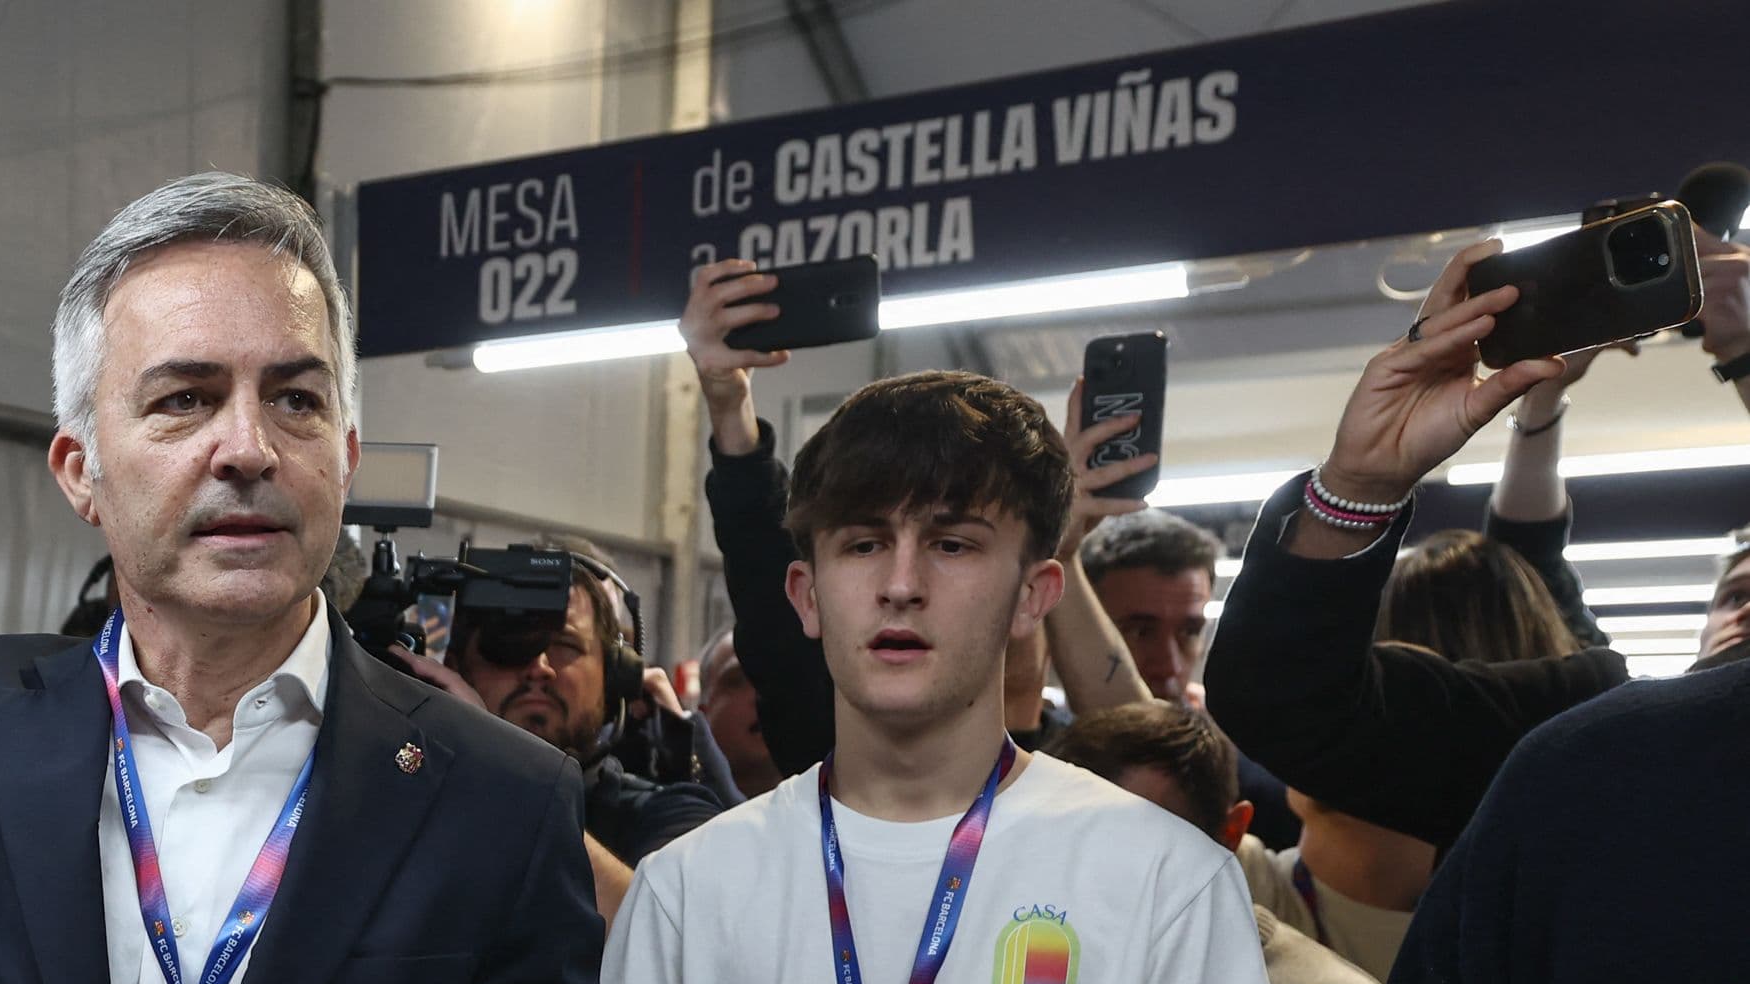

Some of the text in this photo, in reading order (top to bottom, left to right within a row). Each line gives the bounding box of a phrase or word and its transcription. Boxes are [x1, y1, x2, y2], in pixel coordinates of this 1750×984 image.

[692, 69, 1239, 217] de CASTELLA VIÑAS
[440, 174, 578, 256] MESA
[479, 248, 579, 324] 022
[531, 558, 561, 566] SONY
[118, 754, 140, 829] FC BARCELONA
[235, 924, 246, 939] FC
[928, 890, 955, 957] FC BARCELONA
[1013, 904, 1067, 926] CASA
[157, 938, 169, 952] FC
[842, 964, 850, 976] FC
